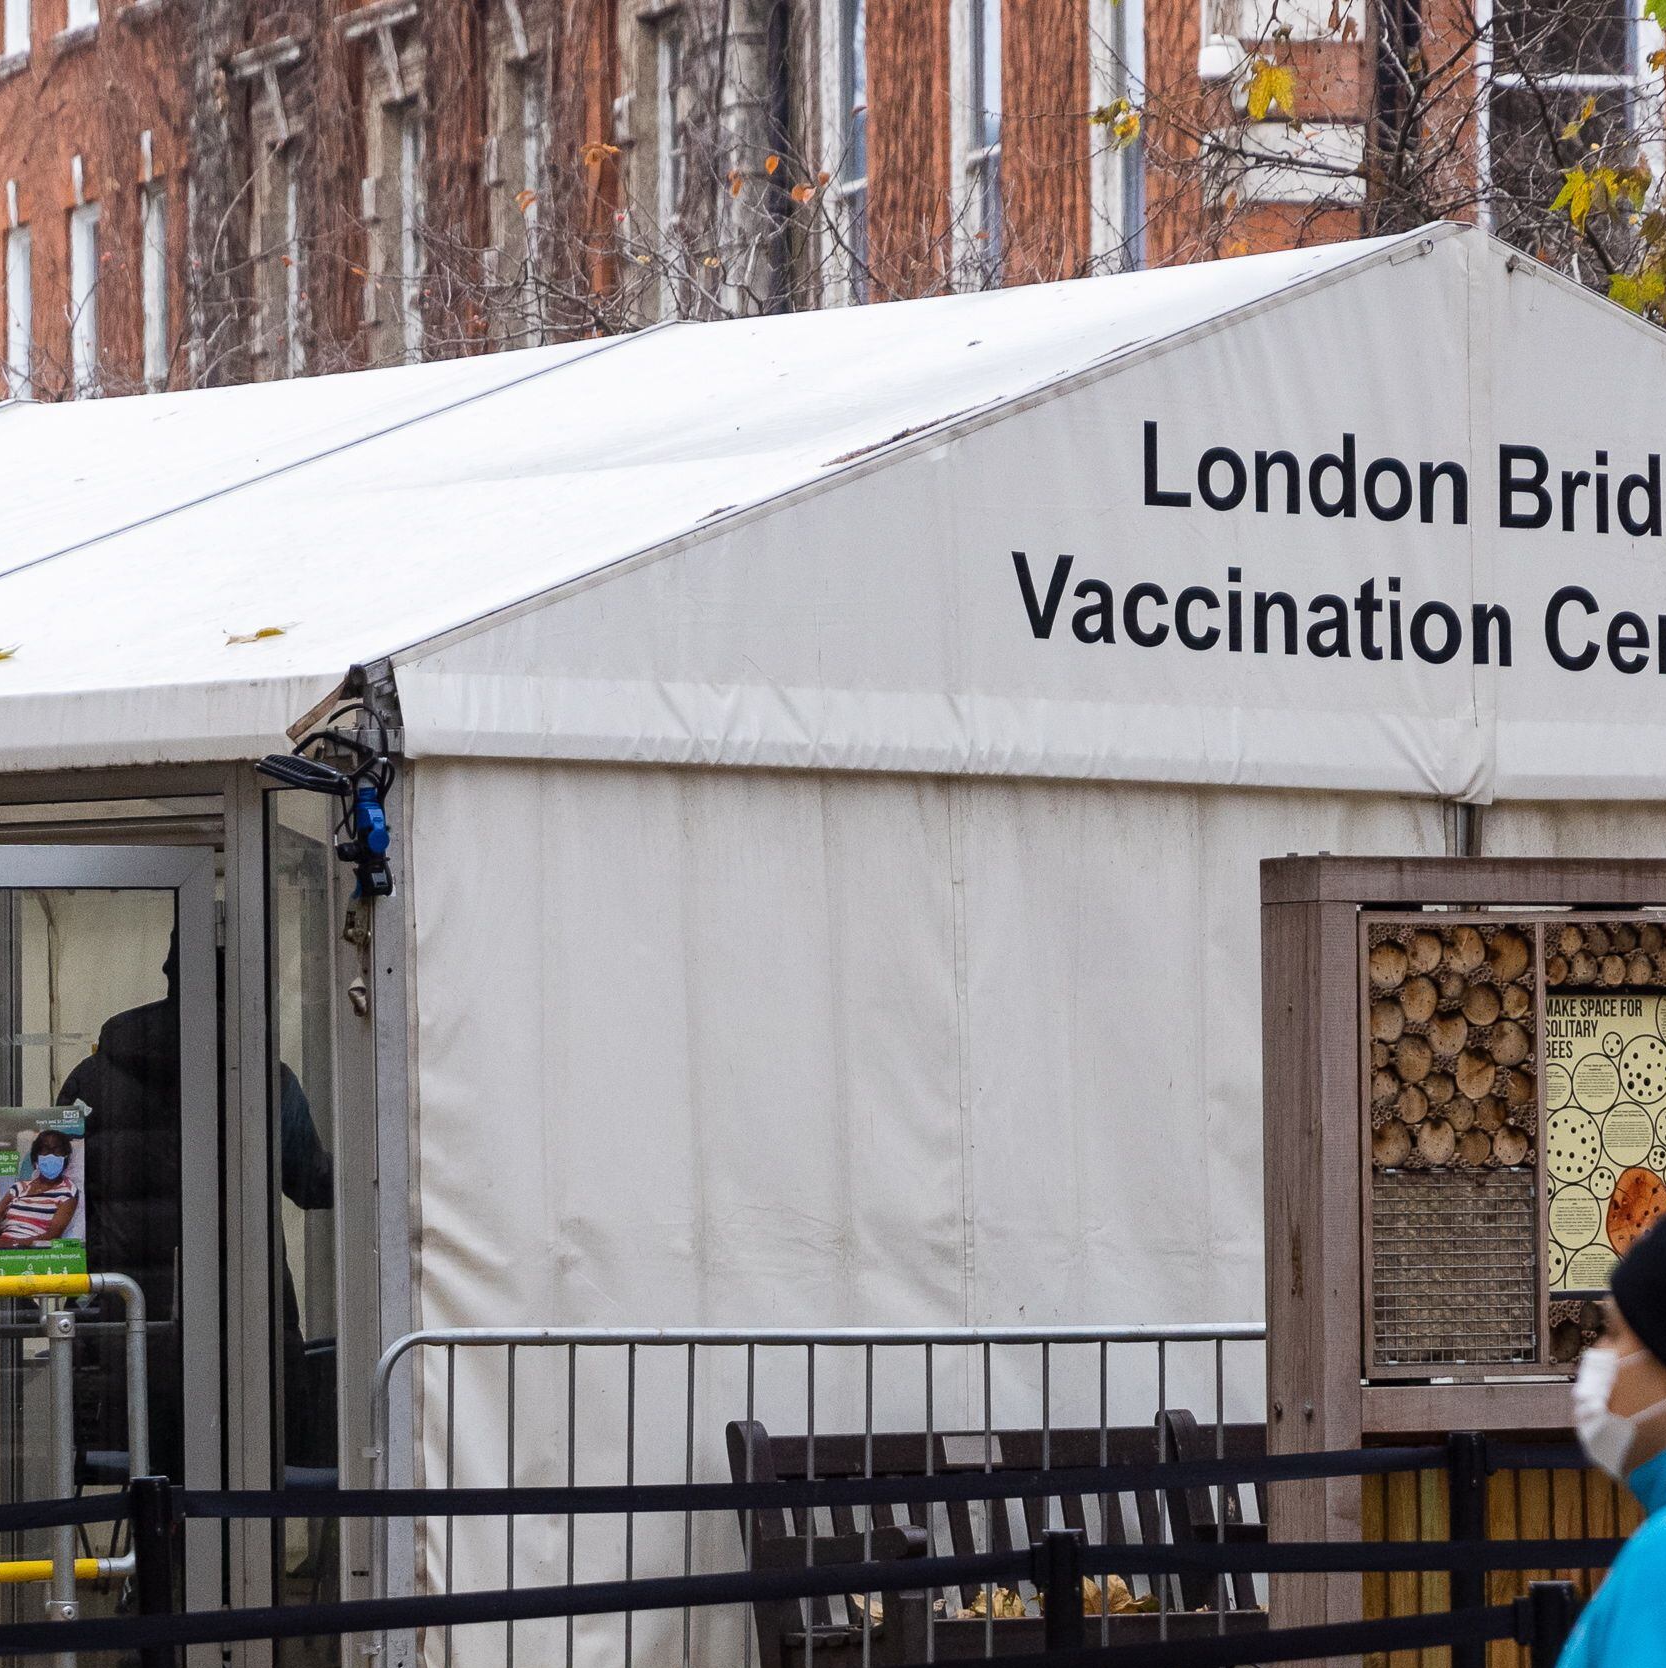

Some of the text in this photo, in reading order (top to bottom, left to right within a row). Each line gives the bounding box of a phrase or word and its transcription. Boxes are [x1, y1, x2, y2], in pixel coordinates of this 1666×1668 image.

[1144, 421, 1467, 524] London
[1012, 551, 1512, 666] Vaccination
[1546, 998, 1643, 1017] MAKE SPACE FOR
[1546, 1019, 1599, 1038] SOLITARY
[1, 1165, 16, 1173] safe
